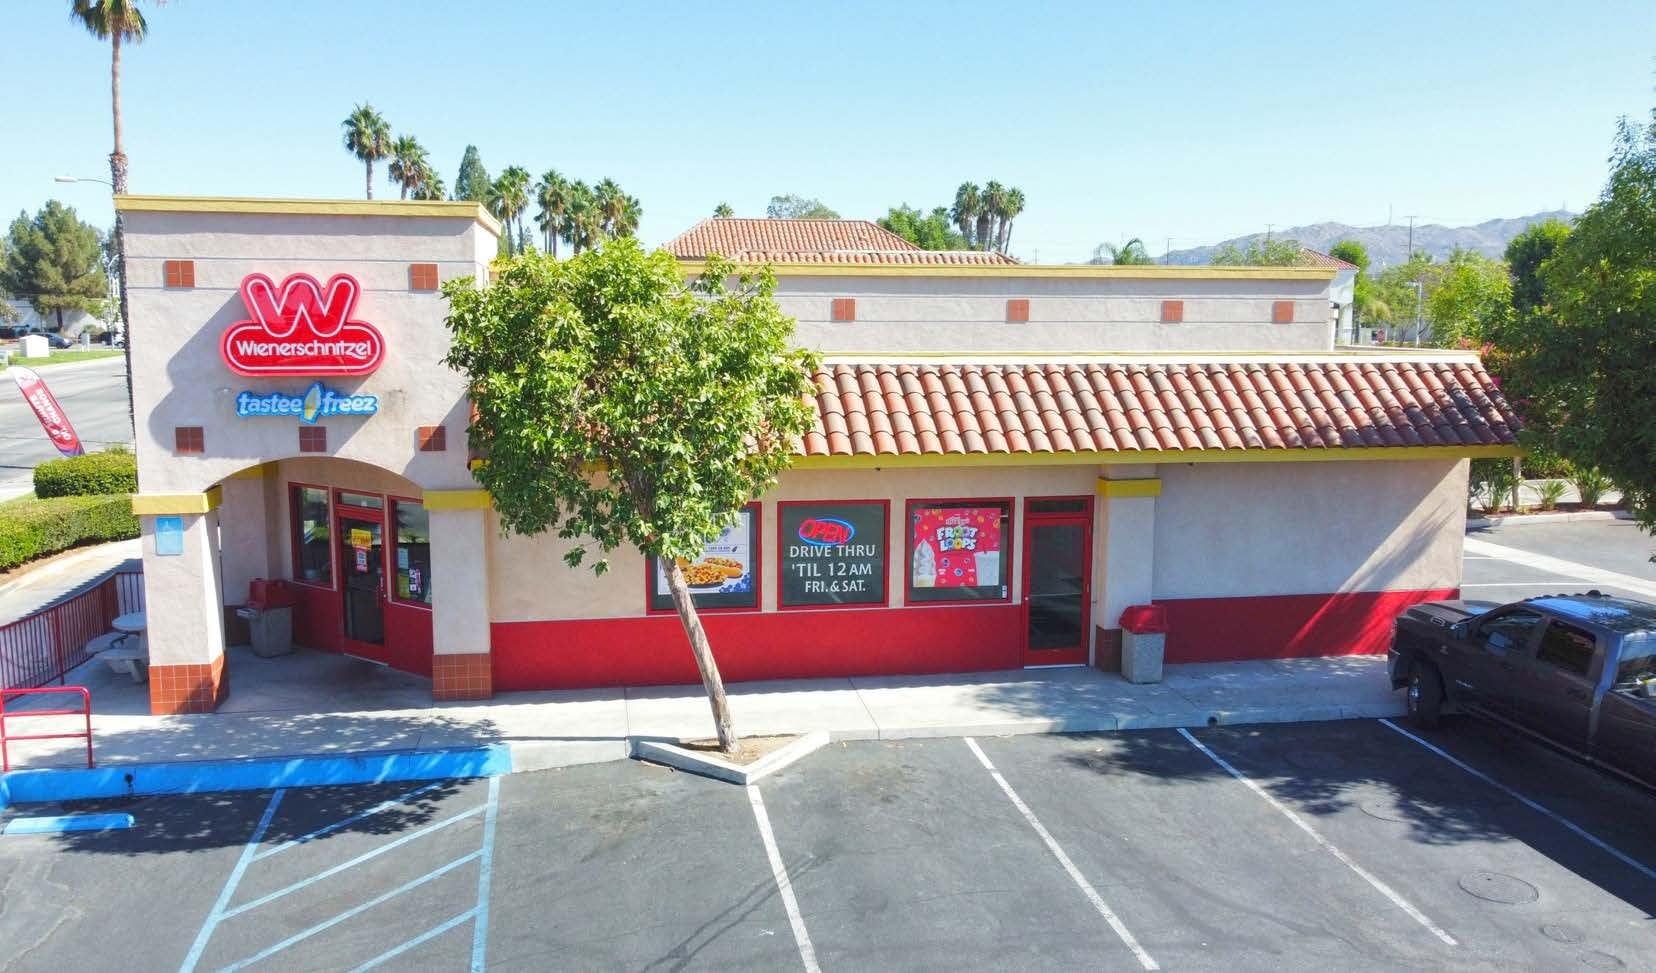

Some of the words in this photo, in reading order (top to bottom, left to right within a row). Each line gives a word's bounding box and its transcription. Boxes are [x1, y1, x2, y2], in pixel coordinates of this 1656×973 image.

[236, 340, 371, 359] Wienerschnitzel
[238, 392, 301, 414] tastee
[323, 391, 377, 413] freez
[801, 519, 851, 545] OPEN
[936, 526, 978, 541] FROOT
[790, 545, 832, 558] DRIVE
[836, 544, 876, 557] THRU
[940, 539, 977, 552] LOOPS
[792, 563, 821, 577] 'TIL
